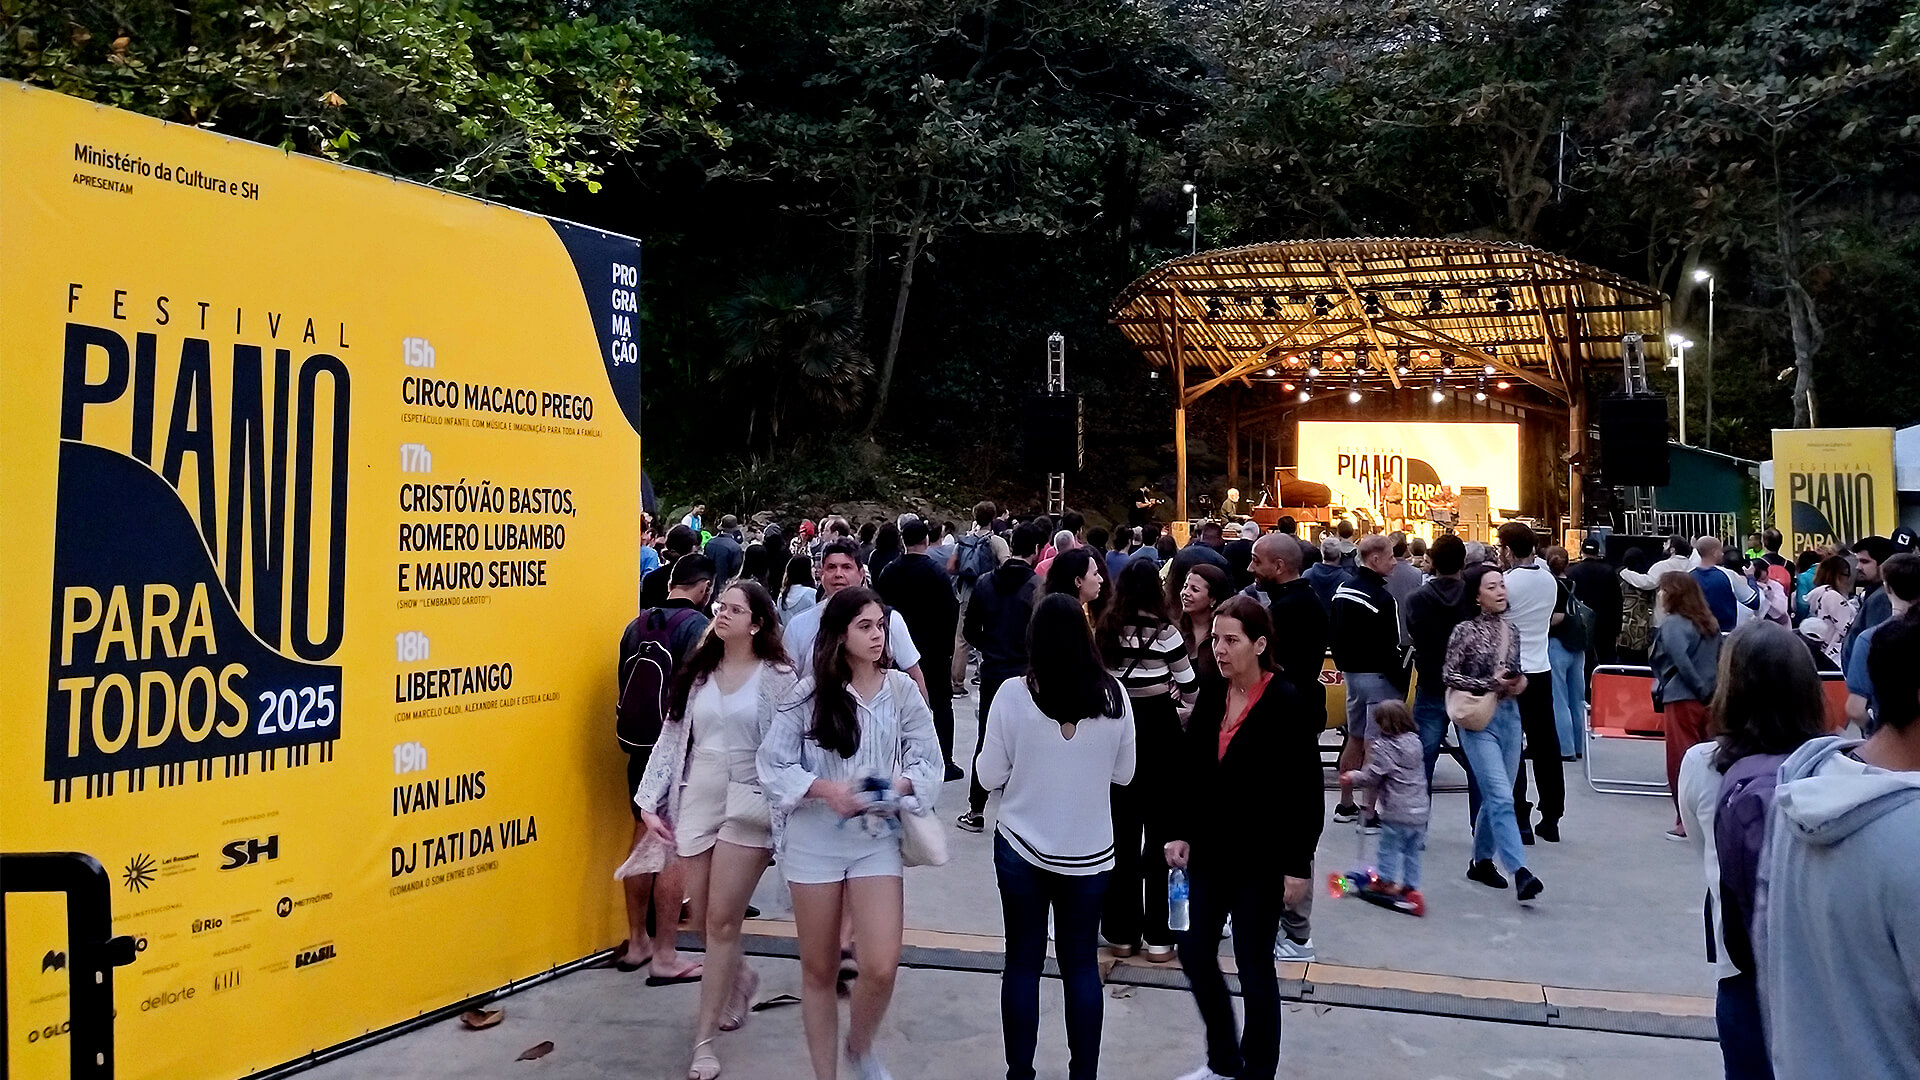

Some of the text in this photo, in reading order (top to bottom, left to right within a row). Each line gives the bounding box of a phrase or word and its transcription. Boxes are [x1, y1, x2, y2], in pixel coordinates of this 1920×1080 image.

[72, 173, 134, 195] APRESENTAM
[74, 143, 259, 200] Ministério da Cultura e SH
[611, 262, 638, 288] PRO
[67, 283, 350, 349] FESTIVAL
[611, 288, 638, 314] GRA
[611, 314, 632, 338] MA
[402, 337, 435, 369] 15h
[611, 336, 638, 367] ÇÃO
[402, 376, 594, 422] CIRCO MACACO PREGO
[444, 416, 471, 428] INFANTIL
[472, 419, 485, 429] COM
[547, 426, 561, 435] PARA
[562, 426, 576, 436] TODA
[399, 443, 433, 473] 17h
[1789, 463, 1872, 472] FESTIVAL
[61, 322, 351, 662] PIANO
[399, 478, 577, 518] CRISTÓVÃO BASTOS,
[1408, 483, 1443, 501] PARA
[1790, 473, 1875, 545] PIANO
[399, 523, 566, 552] ROMERO LUBAMBO
[1795, 533, 1835, 552] PARA
[398, 559, 547, 592] E MAURO SENISE
[61, 582, 217, 666] PARA
[395, 630, 430, 663] 18h
[395, 662, 513, 703] LIBERTANGO
[58, 663, 334, 757] TODOS 2025
[412, 707, 443, 720] MARCELO
[465, 700, 498, 713] ALEXANDRE
[500, 698, 516, 708] CALDI
[522, 694, 541, 705] ESTELA
[393, 741, 428, 775] 19h
[393, 770, 486, 817] IVAN LINS
[219, 834, 279, 870] SH
[391, 815, 538, 877] DJ TATI DA VILA
[425, 877, 431, 888] O
[431, 875, 445, 886] SOM
[446, 868, 465, 882] ENTRE
[466, 866, 475, 877] OS
[204, 918, 223, 931] Rio
[295, 945, 337, 969] BRASIL
[140, 987, 196, 1012] dellarte
[28, 1030, 40, 1043] O
